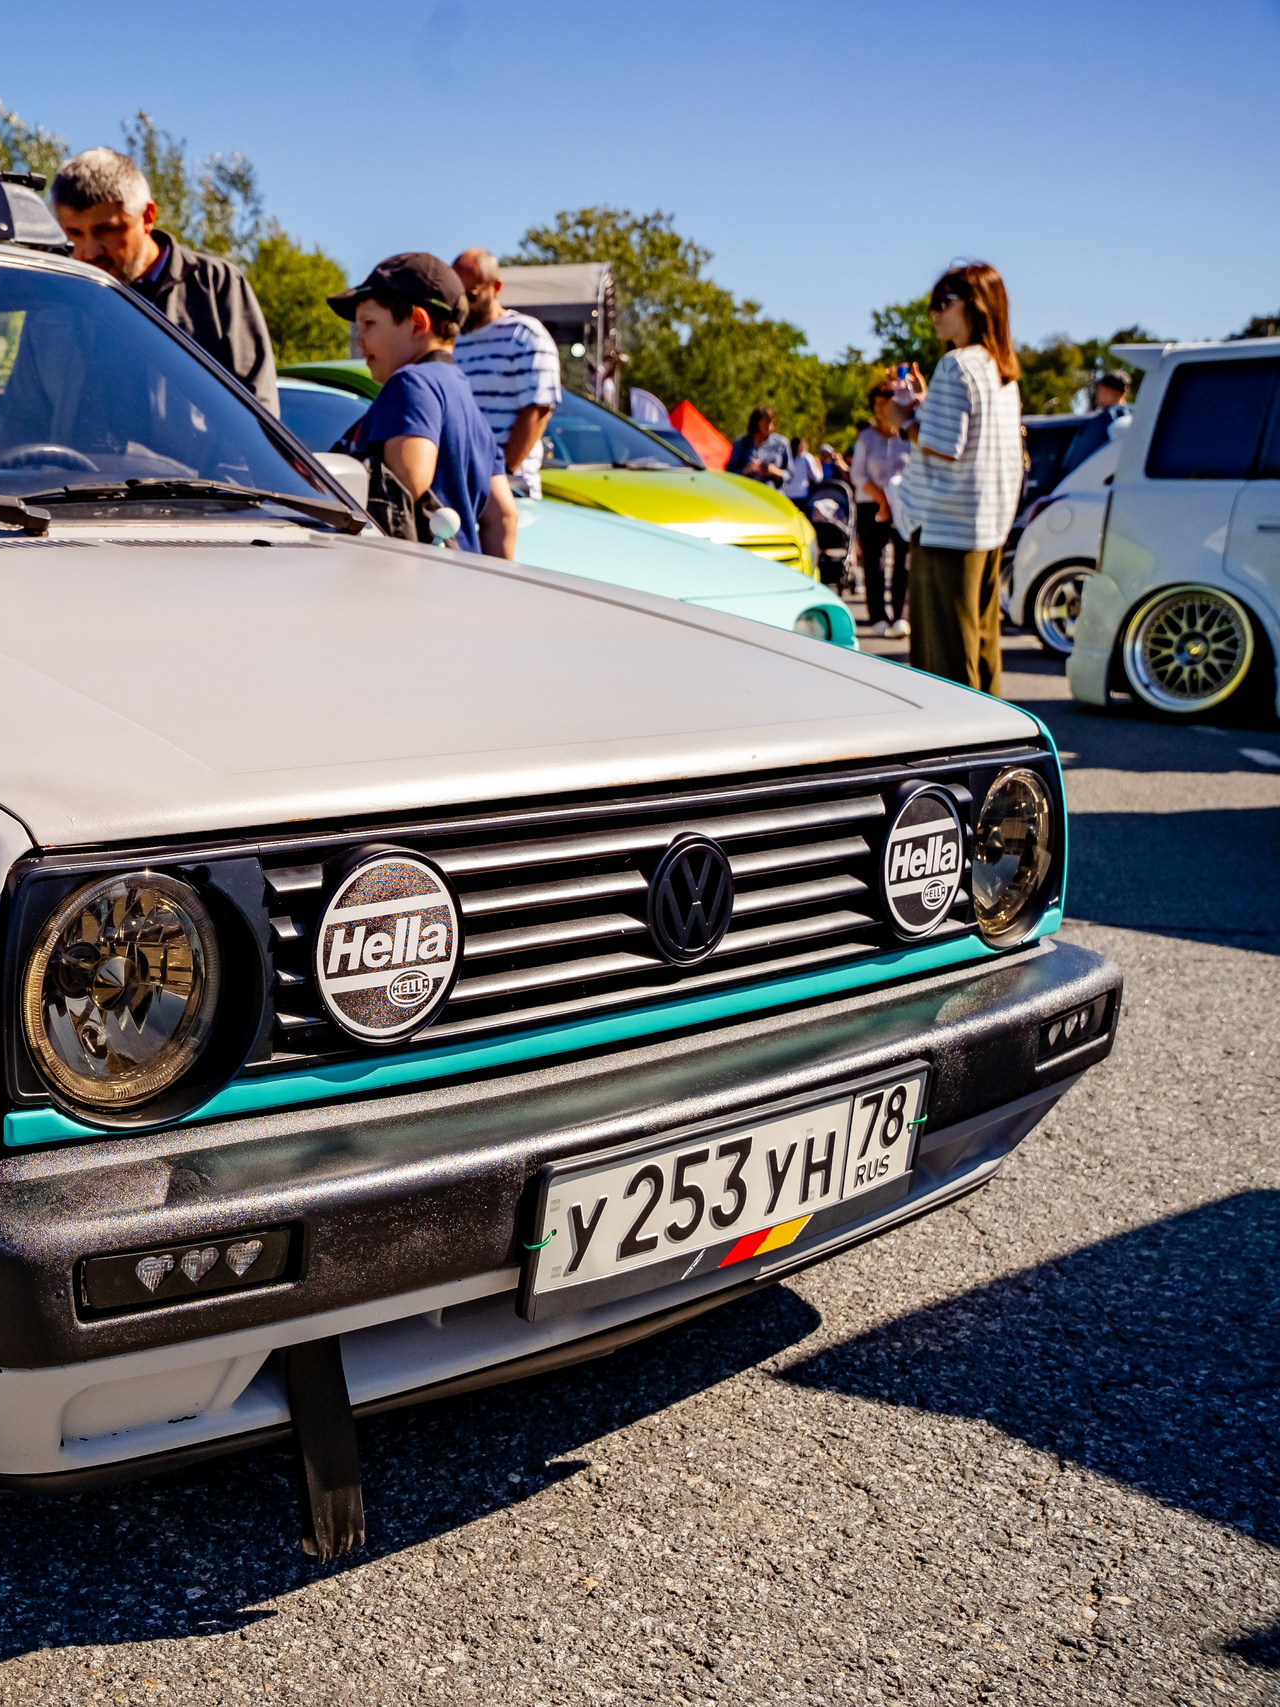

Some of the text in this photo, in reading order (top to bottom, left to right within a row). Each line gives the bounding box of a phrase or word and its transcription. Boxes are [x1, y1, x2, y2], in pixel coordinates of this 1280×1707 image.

[890, 835, 958, 882] Hella
[925, 886, 946, 899] HELLA
[327, 915, 447, 975] Hella
[392, 978, 430, 995] HELLA
[857, 1083, 908, 1160] 78
[853, 1154, 891, 1189] RUS
